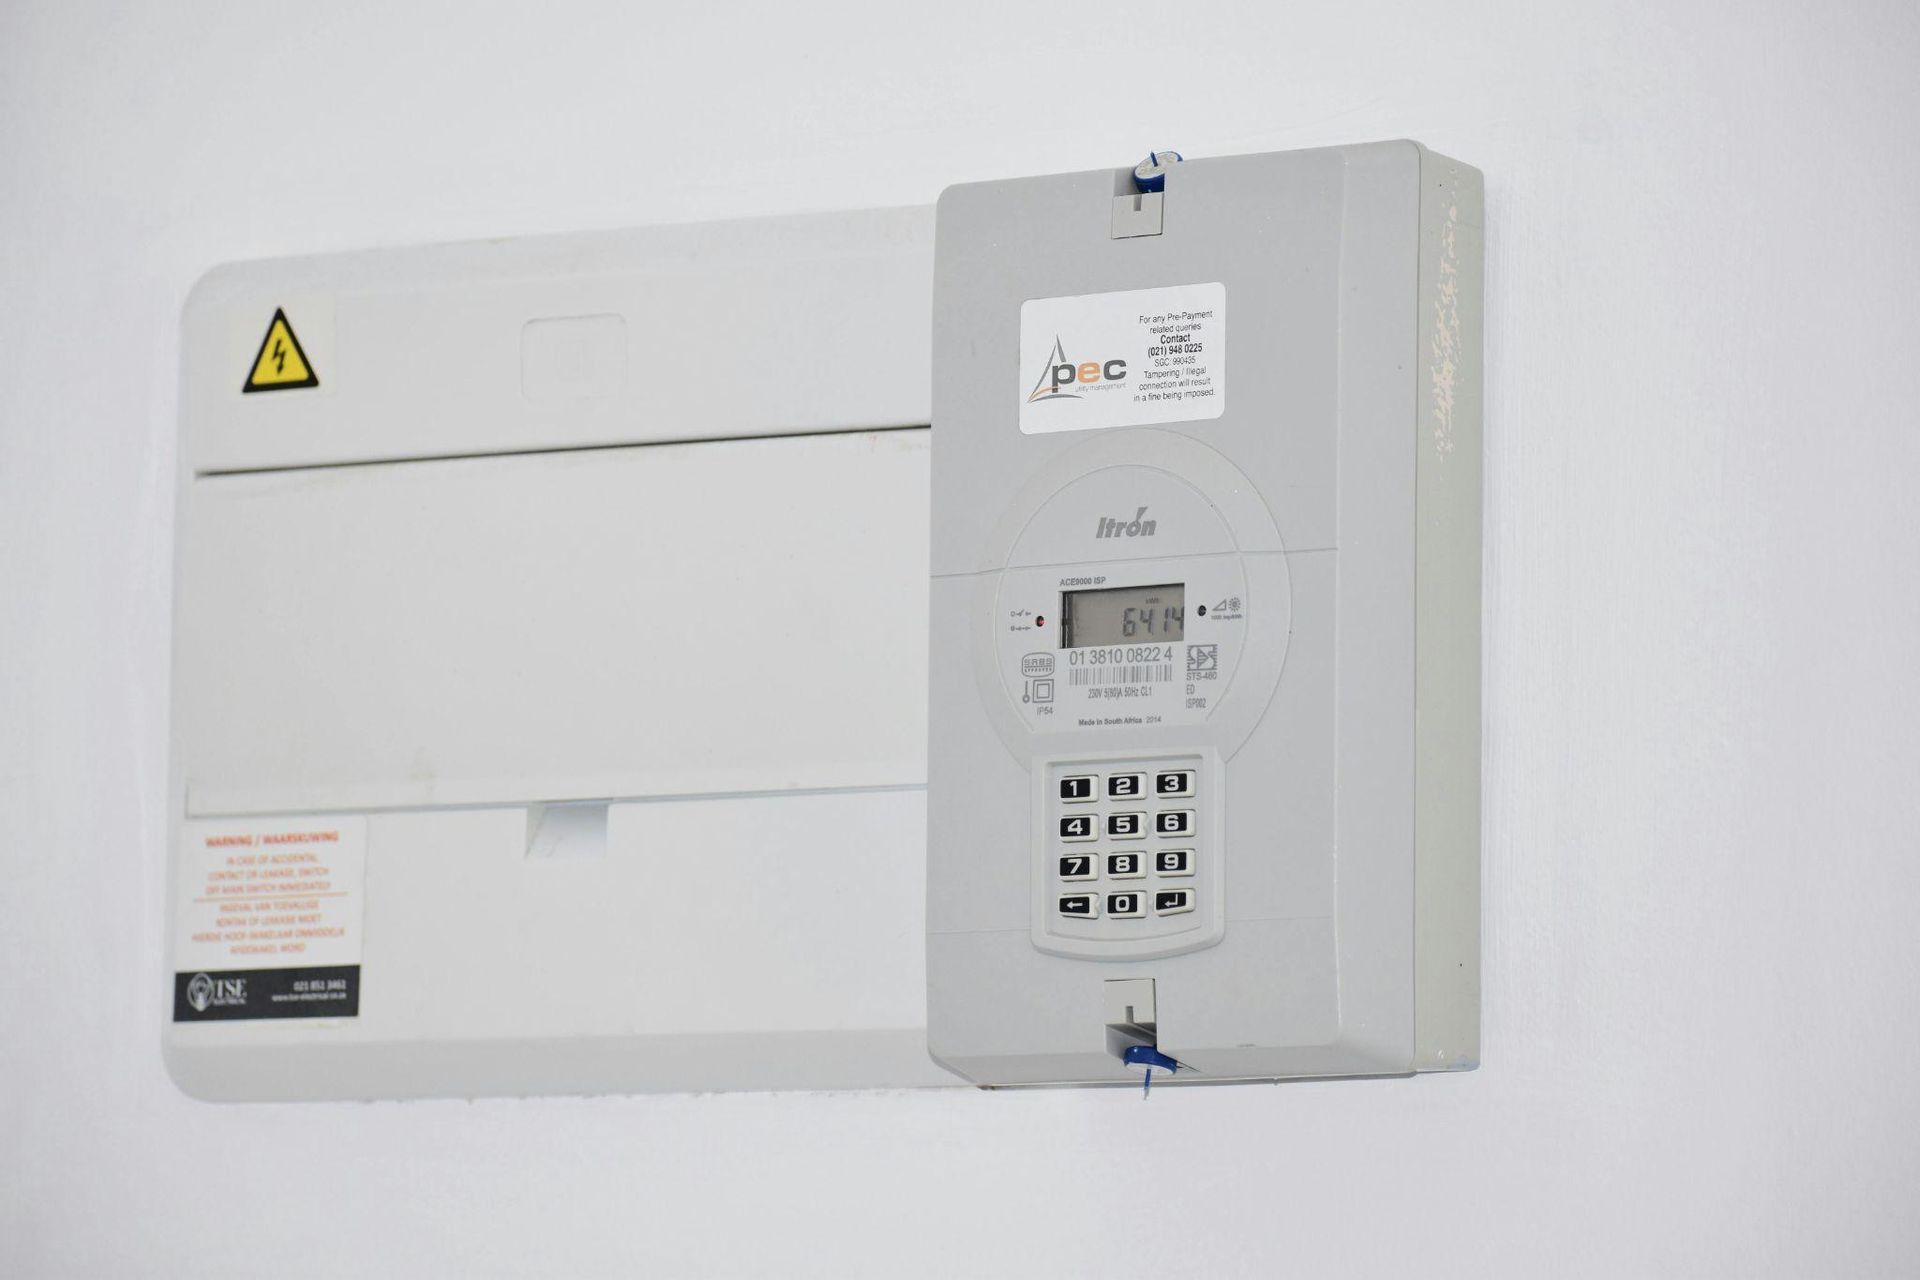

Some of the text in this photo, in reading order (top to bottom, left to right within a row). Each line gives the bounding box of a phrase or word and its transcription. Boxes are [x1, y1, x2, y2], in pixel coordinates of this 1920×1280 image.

[1139, 310, 1213, 325] For any Pre-Payment
[1149, 323, 1202, 334] related queries
[1160, 333, 1191, 344] Contact
[1147, 342, 1203, 358] (021) 948 0225
[1172, 355, 1196, 365] 990435
[1051, 359, 1127, 394] pec
[1143, 369, 1180, 379] Tampering
[1186, 366, 1207, 377] Illegal
[1138, 377, 1211, 391] connection will result
[1133, 393, 1140, 401] in
[1147, 391, 1161, 401] fine
[1162, 390, 1182, 401] being
[1095, 506, 1158, 539] Itron
[1059, 576, 1107, 587] ACE9000 ISP
[1069, 646, 1173, 665] 01 3810 0822 4
[1123, 716, 1142, 724] Africa
[1069, 775, 1180, 797] 1 2 3
[1067, 814, 1179, 835] 4 5 6
[205, 835, 252, 847] WARNING
[1067, 853, 1179, 874] 7 8 9
[1115, 895, 1130, 912] 0
